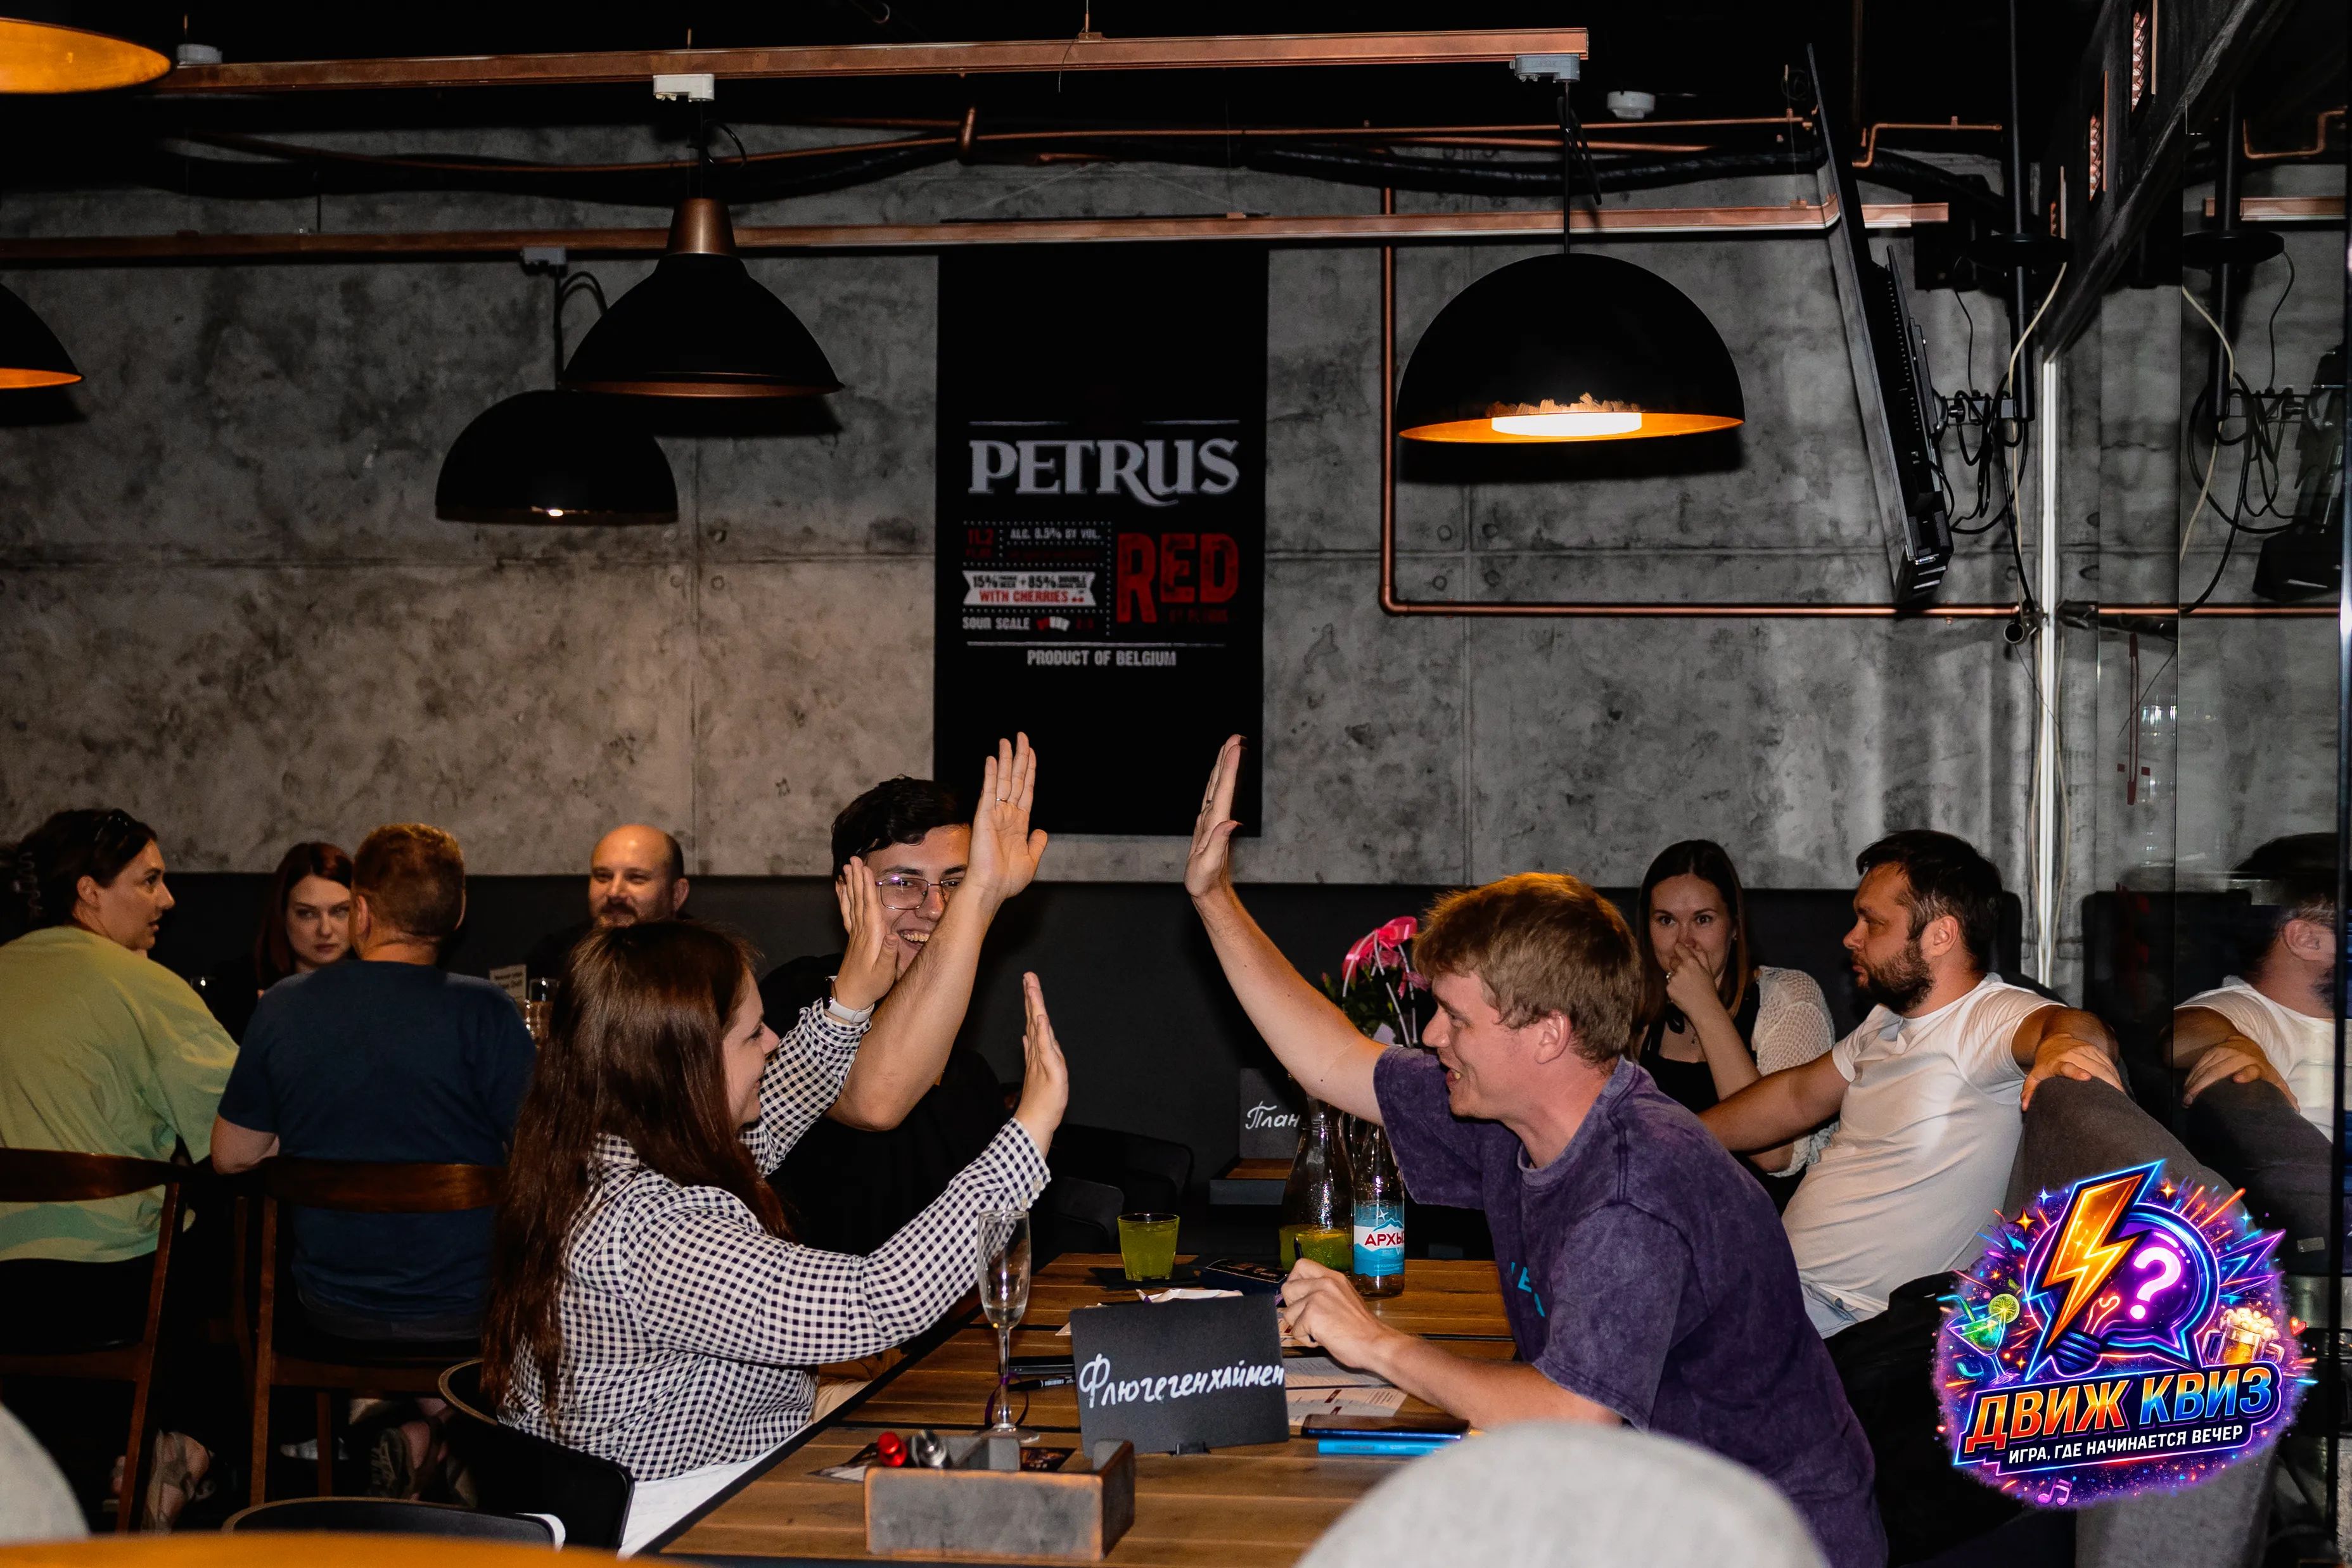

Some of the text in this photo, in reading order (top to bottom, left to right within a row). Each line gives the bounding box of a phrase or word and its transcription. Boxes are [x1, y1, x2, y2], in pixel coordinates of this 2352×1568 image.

[968, 438, 1240, 506] PETRUS
[1116, 532, 1240, 623] RED
[980, 589, 1068, 603] WITH CHERRIES
[962, 616, 1031, 630] SOUR SCALE
[1026, 650, 1177, 666] PRODUCT OF BELGIUM
[1364, 1231, 1405, 1246] АРХЫ
